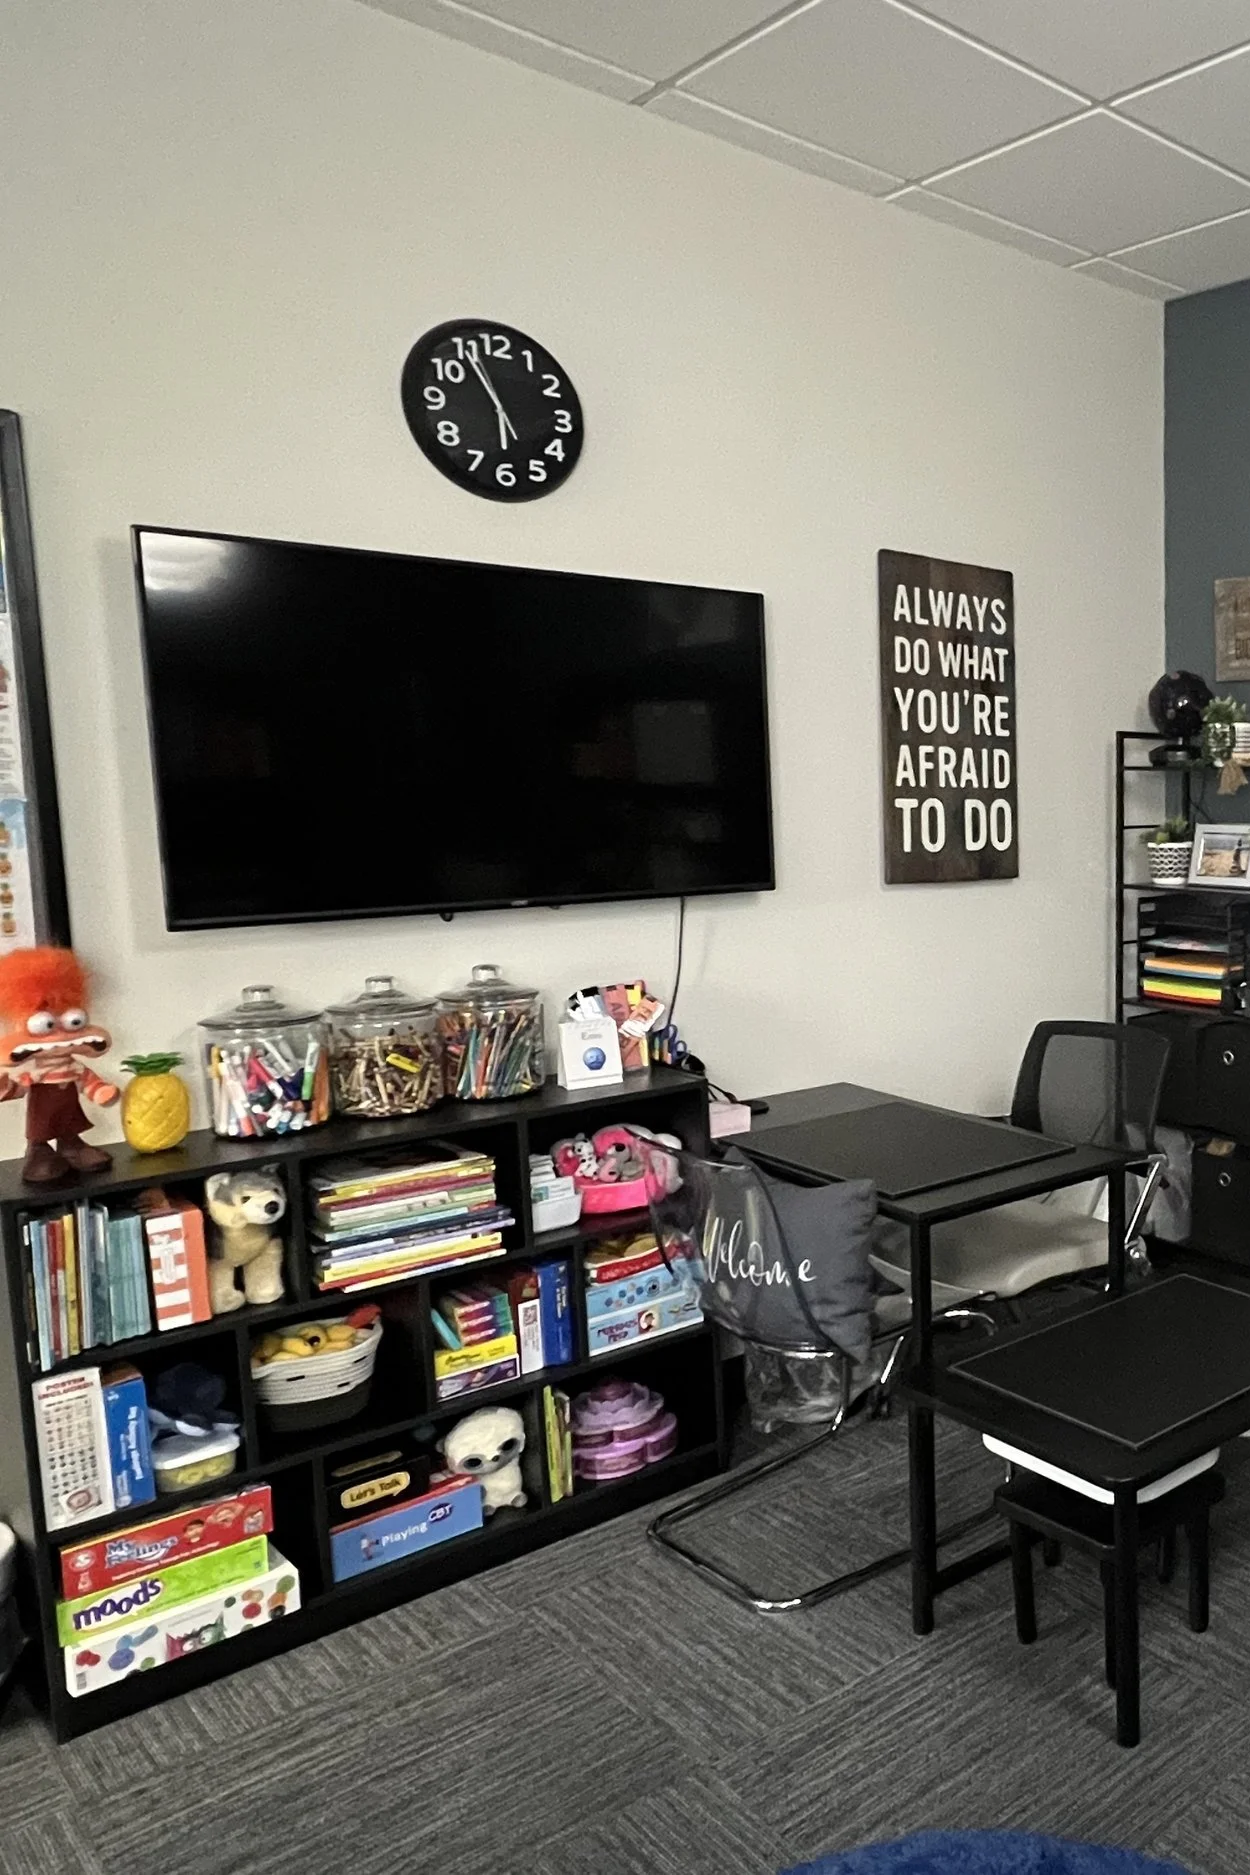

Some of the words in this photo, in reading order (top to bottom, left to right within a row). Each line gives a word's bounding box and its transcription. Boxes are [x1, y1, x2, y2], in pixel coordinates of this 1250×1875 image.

[452, 337, 478, 362] 11
[479, 333, 512, 359] 12
[431, 358, 465, 383] 10
[522, 350, 533, 372] 1
[423, 386, 446, 410] 9
[541, 374, 561, 398] 2
[437, 420, 460, 446] 8
[554, 409, 573, 433] 3
[467, 449, 484, 471] 7
[544, 438, 565, 462] 4
[495, 463, 516, 487] 6
[529, 459, 547, 482] 5
[894, 584, 1006, 635] ALWAYS
[895, 636, 929, 676] DO
[938, 642, 1008, 682] WHAT
[894, 687, 1010, 737] YOU'RE
[896, 745, 1010, 790] AFRAID
[895, 798, 946, 853] TO
[964, 798, 1012, 852] DO
[350, 1485, 376, 1502] Let's
[379, 1477, 401, 1493] Talk
[381, 1521, 428, 1546] Playing
[428, 1504, 453, 1521] CBT
[72, 1578, 161, 1631] moods
